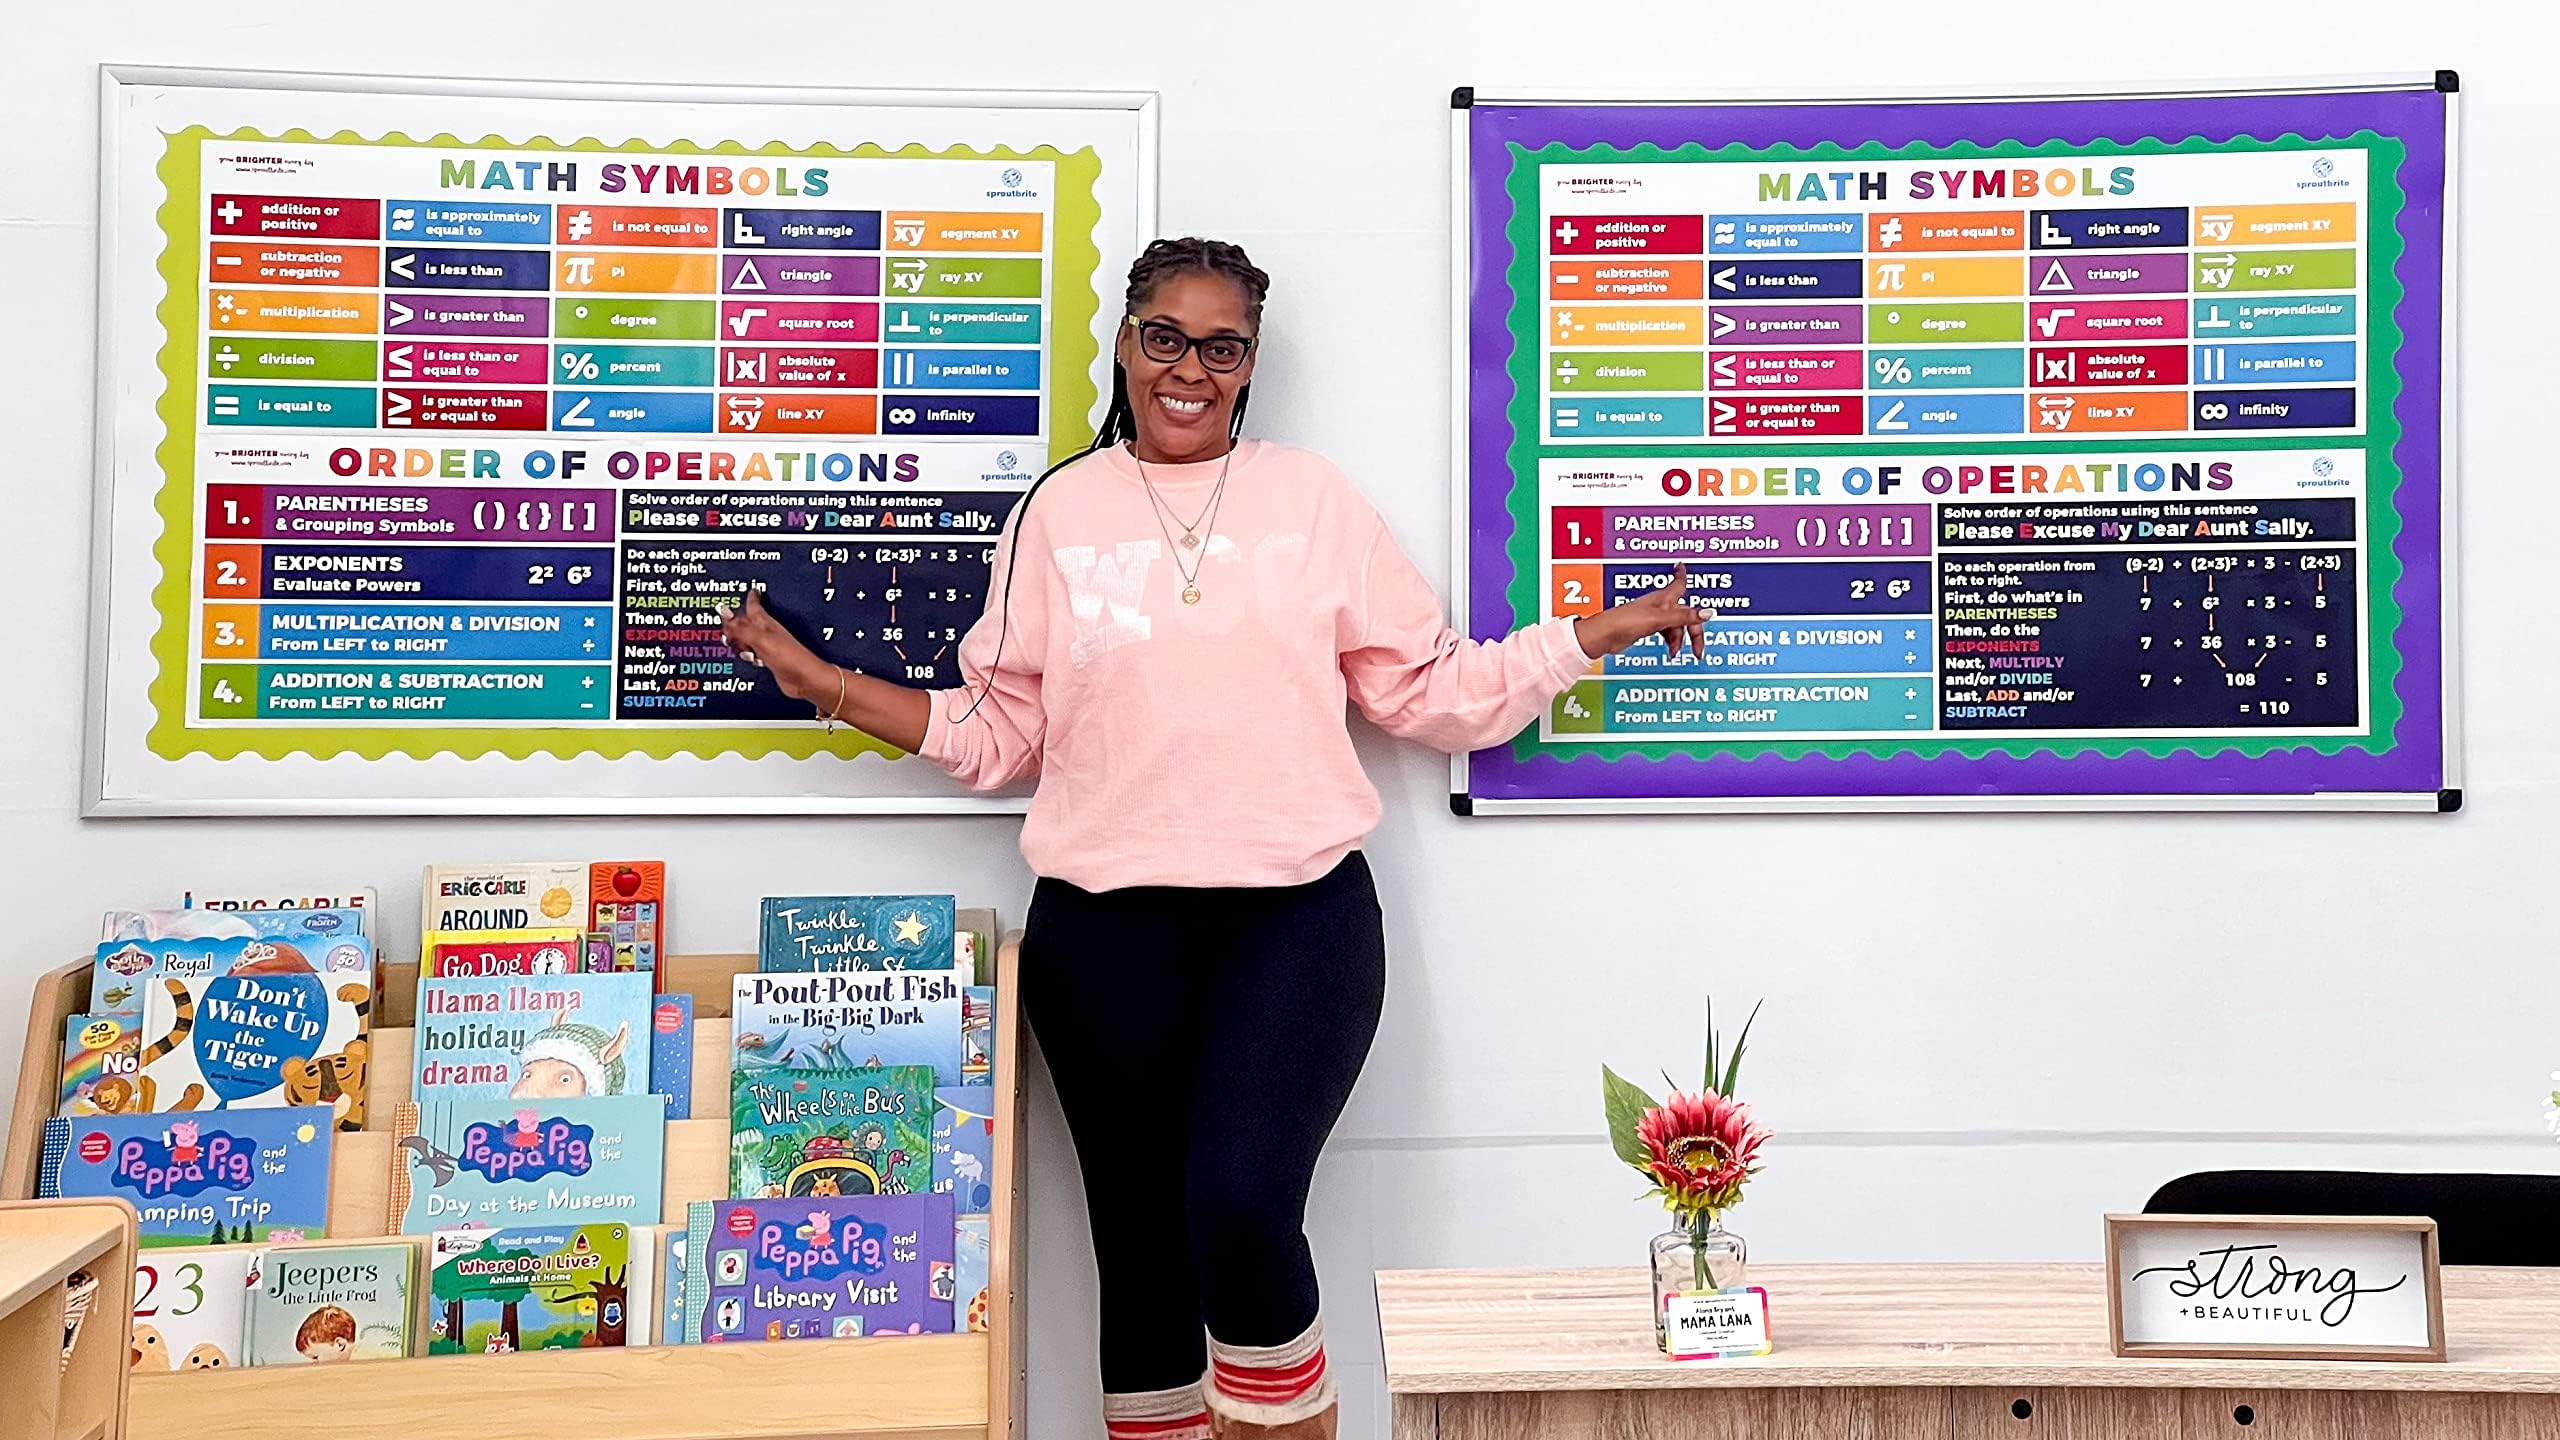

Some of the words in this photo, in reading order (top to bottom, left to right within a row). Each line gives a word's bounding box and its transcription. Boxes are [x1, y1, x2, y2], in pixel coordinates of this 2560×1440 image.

[440, 159, 576, 191] MATH
[599, 163, 829, 197] SYMBOLS
[1759, 172, 1887, 201] MATH
[1909, 166, 2135, 199] SYMBOLS
[261, 203, 321, 216] addition
[323, 205, 340, 217] or
[426, 208, 437, 220] is
[441, 210, 541, 226] approximately
[261, 218, 318, 232] positive
[426, 224, 462, 237] equal
[465, 225, 482, 236] to
[781, 223, 812, 239] right
[816, 225, 854, 239] angle
[941, 230, 997, 242] segment
[1000, 228, 1020, 240] XY
[780, 269, 832, 283] triangle
[1595, 267, 1669, 279] subtraction
[1595, 282, 1610, 293] or
[1612, 282, 1668, 296] negative
[778, 318, 823, 331] square
[826, 318, 855, 330] root
[1595, 320, 1686, 333] multiplication
[609, 361, 661, 377] percent
[927, 409, 975, 424] infinity
[329, 448, 500, 479] ORDER
[523, 450, 586, 480] OF
[607, 451, 919, 482] OPERATIONS
[1661, 468, 1821, 497] ORDER
[1842, 467, 1901, 495] OF
[1922, 462, 2233, 495] OPERATIONS
[276, 495, 429, 513] PARENTHESES
[629, 494, 668, 505] Solve
[670, 494, 708, 506] order
[712, 494, 727, 506] of
[730, 495, 805, 509] operations
[809, 495, 847, 509] using
[850, 495, 877, 507] this
[881, 496, 943, 508] sentence
[276, 519, 287, 533] &
[292, 518, 374, 535] Grouping
[378, 518, 455, 534] Symbols
[1944, 523, 2013, 541] Please
[2019, 522, 2095, 539] Excuse
[2101, 521, 2132, 542] My
[2139, 521, 2189, 538] Dear
[2195, 519, 2249, 537] Aunt
[2255, 518, 2314, 540] Sally.
[1945, 591, 1984, 606] First,
[1987, 592, 2008, 604] do
[2068, 591, 2083, 604] in
[1945, 607, 2057, 621] PARENTHESES
[272, 614, 445, 631] MULTIPLICATION
[450, 616, 463, 631] &
[469, 615, 560, 632] DIVISION
[1989, 656, 2064, 670] MULTIPLY
[2000, 673, 2053, 685] DIVIDE
[2225, 674, 2256, 687] 108
[1615, 688, 1710, 704] ADDITION
[1715, 688, 1728, 703] &
[1733, 686, 1869, 702] SUBTRACTION
[1615, 710, 1655, 724] From
[1663, 710, 1701, 723] LEFT
[1705, 710, 1723, 723] to
[1728, 709, 1778, 722] RIGHT
[2259, 702, 2290, 716] 110
[441, 881, 482, 897] ERIC
[484, 880, 526, 896] CARLE
[440, 909, 528, 930] AROUND
[165, 954, 211, 979] Royal
[337, 956, 355, 966] 50
[237, 978, 307, 1010] Don't
[739, 989, 751, 998] The
[752, 976, 895, 1005] Pout-Pout
[901, 975, 958, 1003] Fish
[426, 989, 500, 1014] llama
[508, 986, 582, 1011] llama
[90, 1023, 108, 1033] 50
[206, 998, 278, 1029] Wake
[283, 1011, 320, 1041] Up
[769, 1014, 780, 1025] in
[783, 1014, 799, 1025] the
[802, 1008, 876, 1036] Big-Big
[879, 1006, 924, 1026] Dark
[234, 1029, 264, 1047] the
[424, 1026, 526, 1054] holiday
[204, 1039, 278, 1071] Tiger
[422, 1060, 509, 1086] drama
[750, 1082, 774, 1101] The
[843, 1091, 855, 1101] on
[759, 1088, 837, 1125] Wheels
[839, 1099, 860, 1116] the
[863, 1088, 905, 1115] Bus
[600, 1133, 622, 1145] and
[263, 1145, 287, 1159] and
[466, 1126, 544, 1178] Peppa
[548, 1123, 588, 1166] Pig
[600, 1149, 621, 1161] the
[120, 1141, 205, 1194] Peppa
[208, 1137, 249, 1180] Pig
[263, 1161, 285, 1175] the
[225, 1197, 272, 1223] Trip
[427, 1194, 471, 1218] Day
[480, 1201, 500, 1213] at
[508, 1197, 538, 1213] the
[547, 1187, 636, 1210] Museum
[499, 1236, 522, 1246] Read
[525, 1236, 542, 1245] and
[544, 1235, 564, 1245] Play
[892, 1231, 917, 1245] and
[762, 1225, 839, 1277] Peppa
[843, 1222, 880, 1265] Pig
[892, 1249, 917, 1263] the
[459, 1260, 515, 1275] Where
[520, 1258, 541, 1271] Do
[546, 1257, 551, 1269] I
[556, 1255, 600, 1269] Live?
[268, 1261, 379, 1298] Jeepers
[489, 1274, 529, 1284] Animals
[531, 1273, 541, 1282] at
[543, 1273, 571, 1282] Home
[2132, 1244, 2407, 1327] strong
[172, 1263, 204, 1316] 3
[283, 1293, 304, 1305] the
[308, 1291, 343, 1304] Little
[346, 1289, 377, 1303] Frog
[754, 1283, 837, 1311] Library
[847, 1279, 899, 1306] Visit
[1680, 1316, 1716, 1329] MAMA
[1720, 1314, 1752, 1326] LANA
